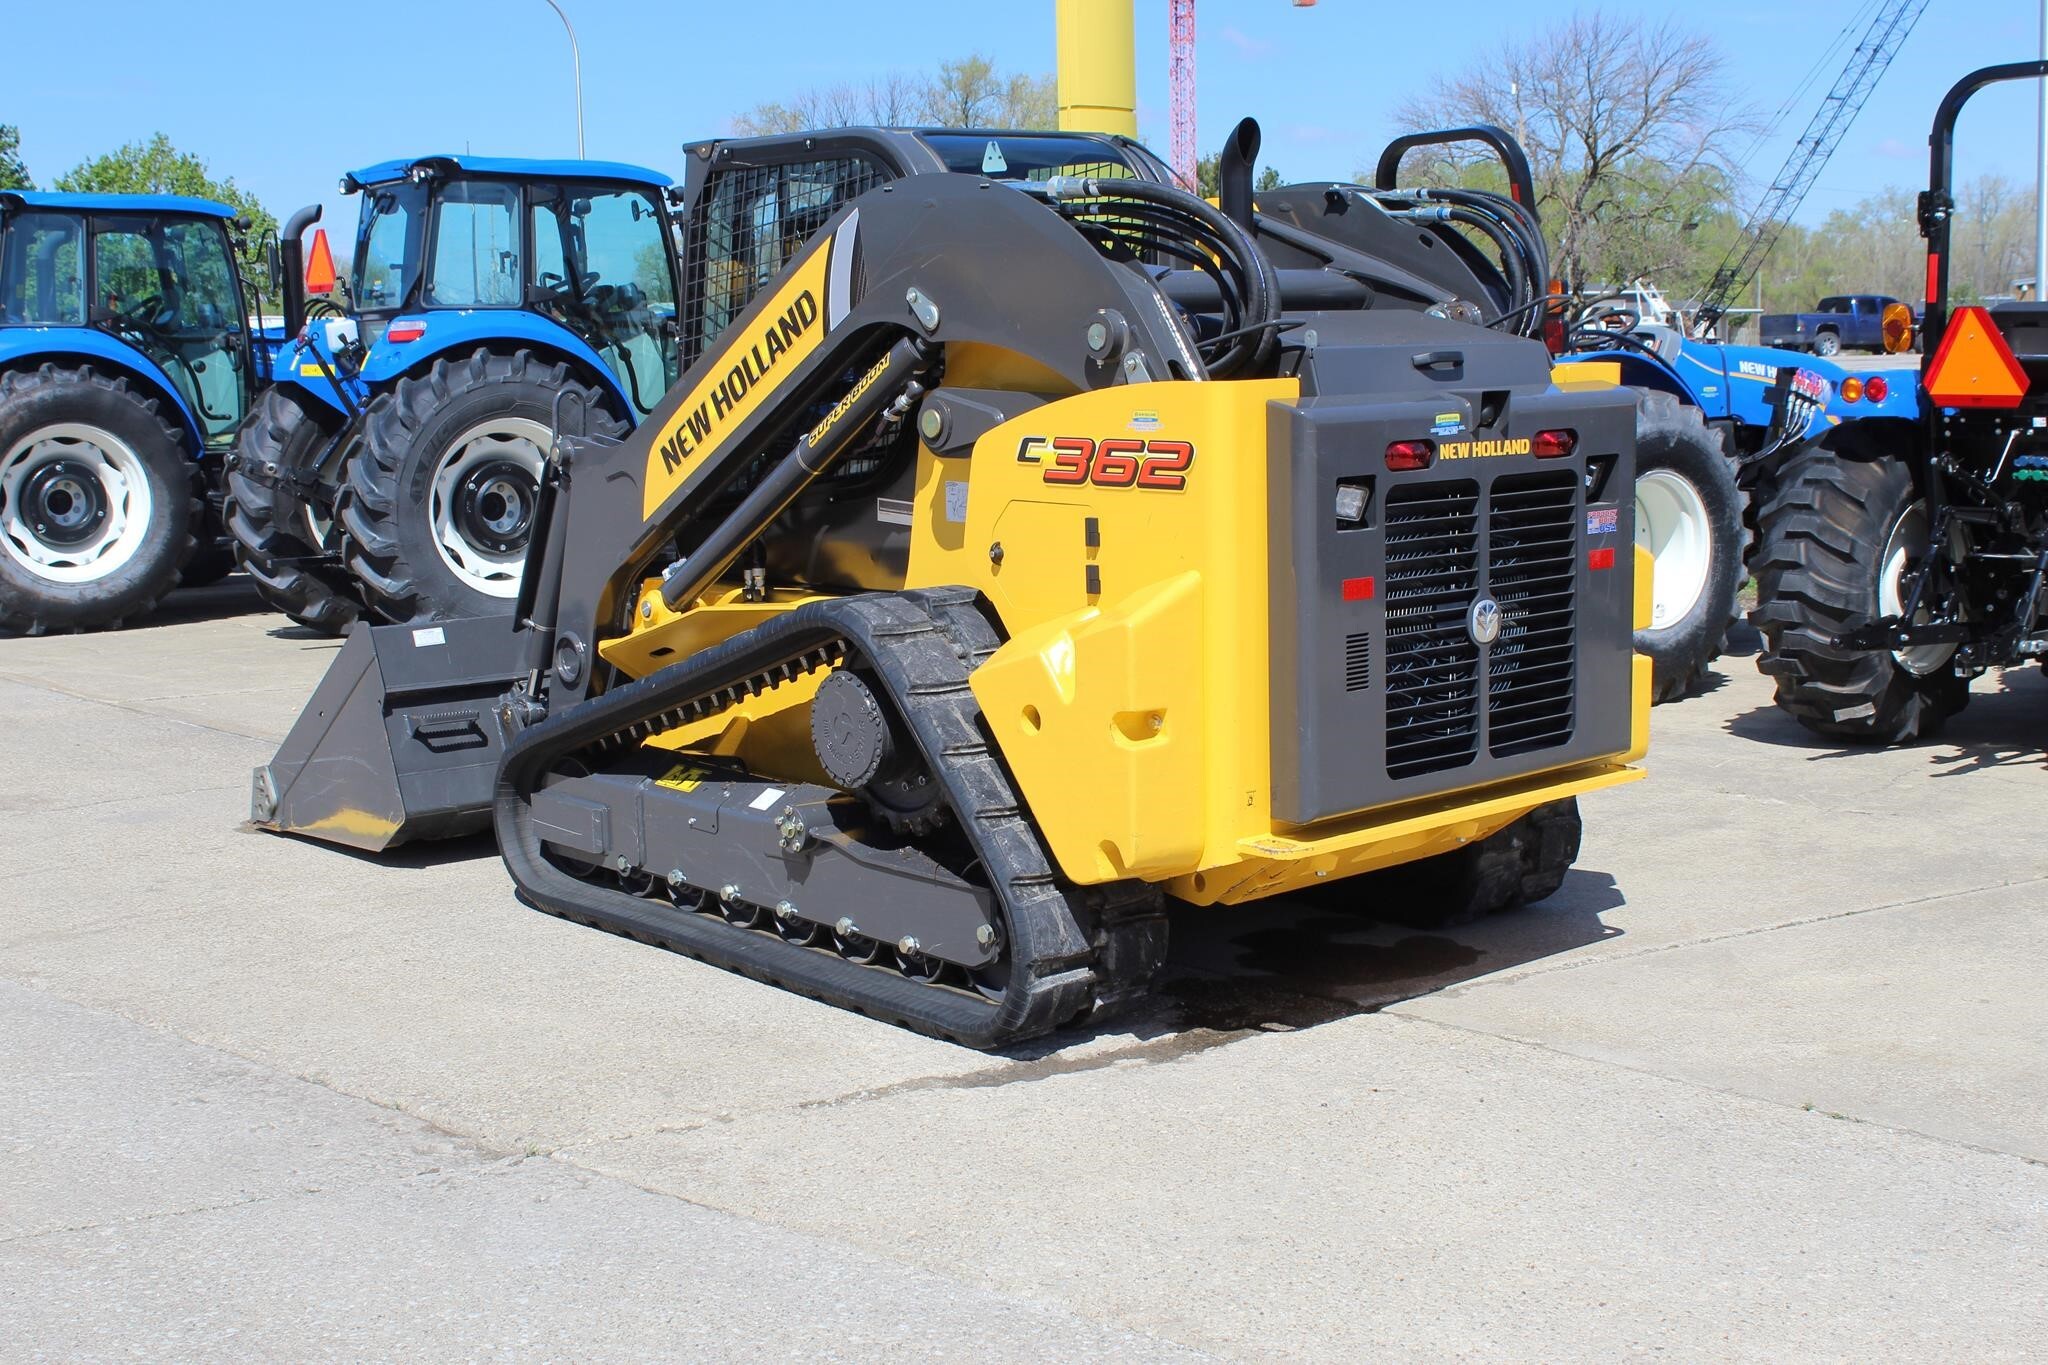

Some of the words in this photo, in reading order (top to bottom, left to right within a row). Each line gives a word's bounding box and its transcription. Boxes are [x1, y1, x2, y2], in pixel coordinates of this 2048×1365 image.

[1739, 360, 1765, 376] NEW
[660, 401, 712, 475] NEW
[710, 289, 817, 421] HOLLAND
[1439, 441, 1470, 460] NEW
[1472, 438, 1531, 458] HOLLAND
[1599, 522, 1617, 533] USA
